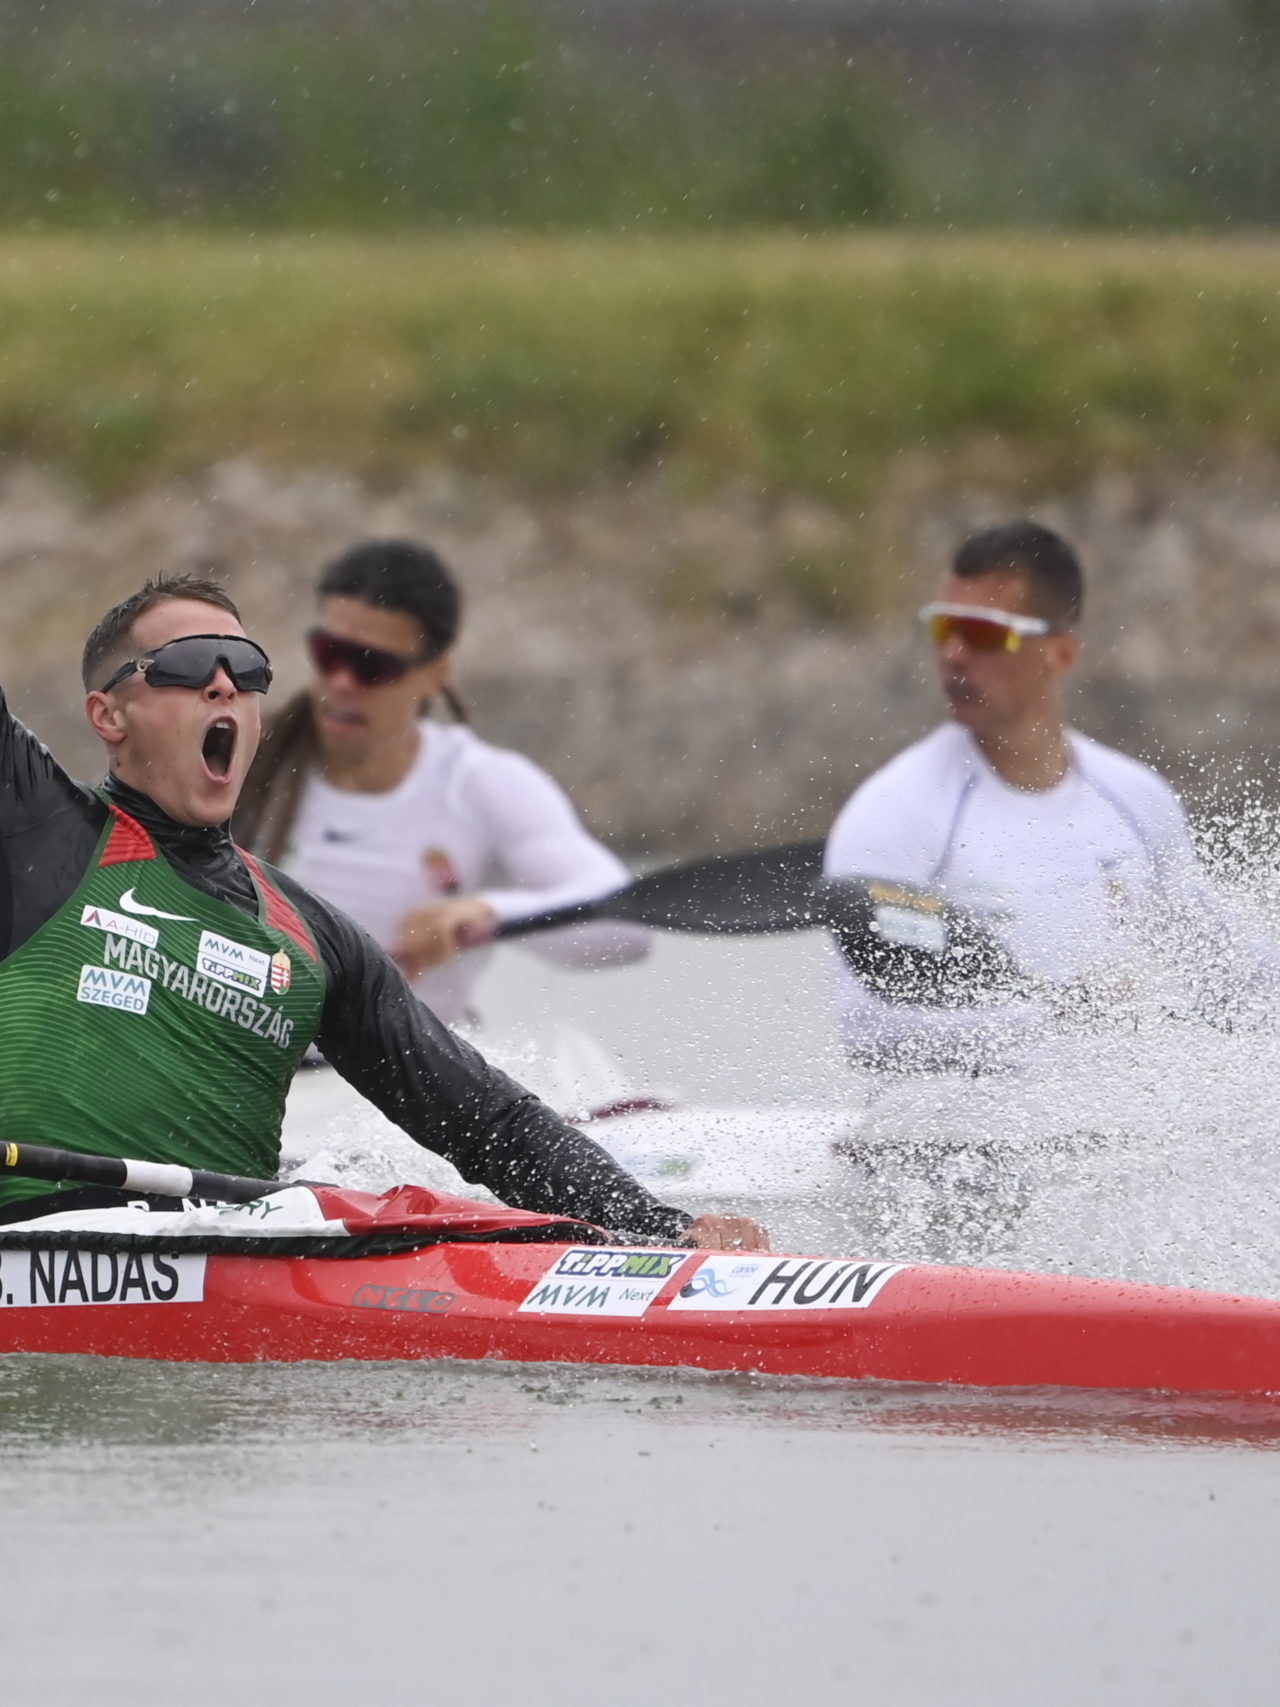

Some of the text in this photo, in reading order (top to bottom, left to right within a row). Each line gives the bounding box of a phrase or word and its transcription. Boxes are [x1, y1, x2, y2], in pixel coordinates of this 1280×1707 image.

[204, 938, 244, 961] MVM
[83, 969, 146, 996] MVM
[104, 933, 294, 1049] MAGYARORSZÁG
[80, 987, 144, 1011] SZEGED
[747, 1260, 897, 1305] HUN
[526, 1284, 653, 1308] MVM Next
